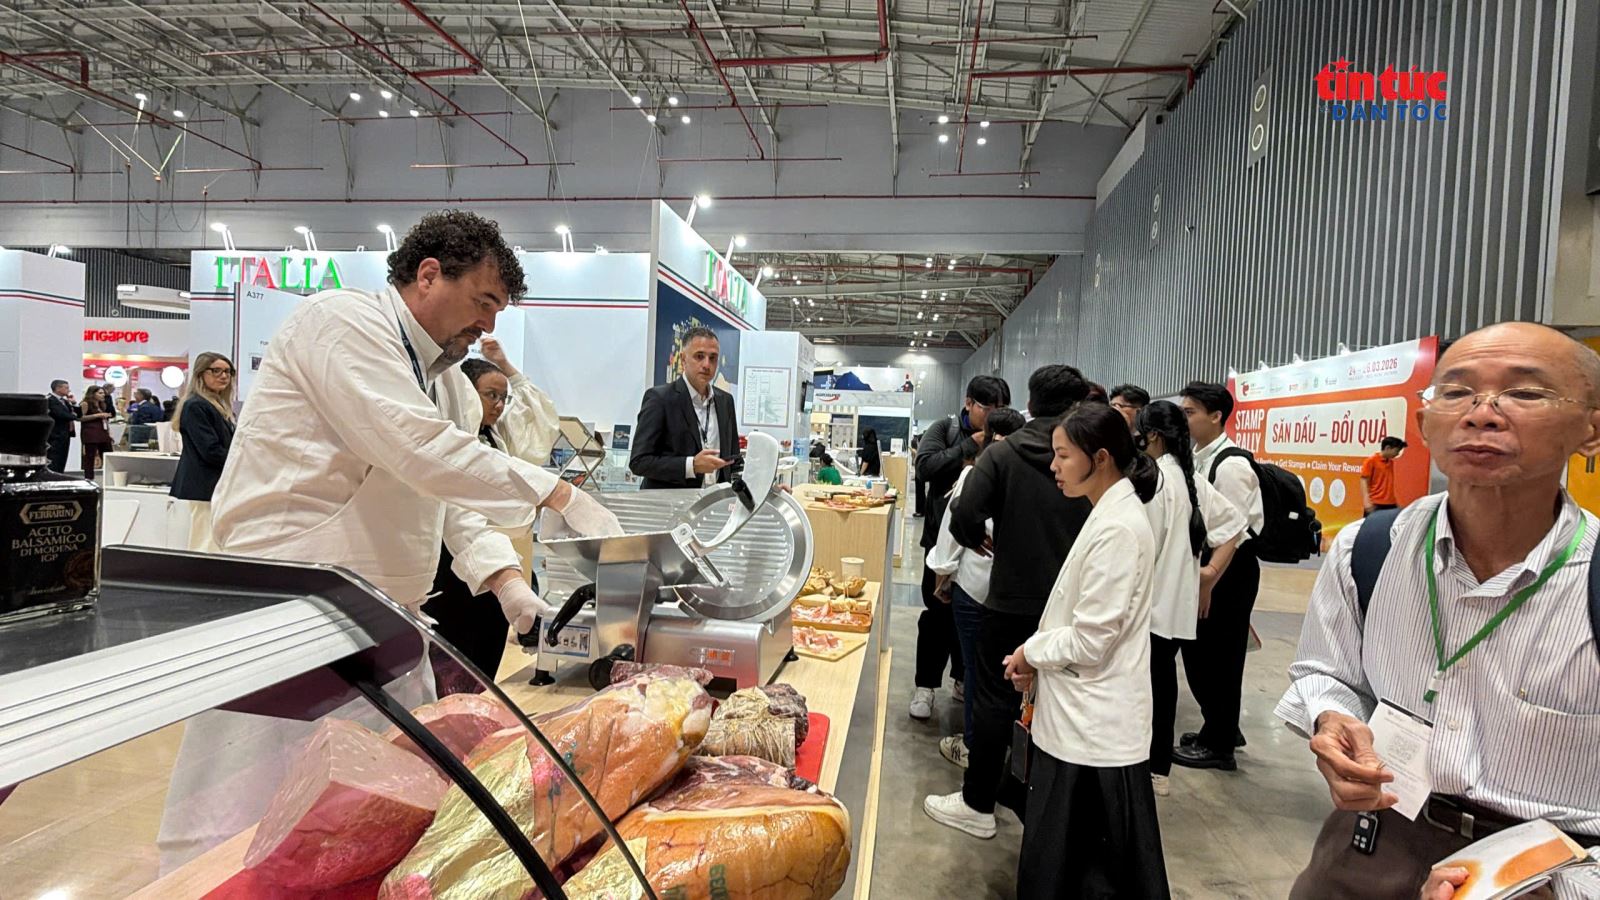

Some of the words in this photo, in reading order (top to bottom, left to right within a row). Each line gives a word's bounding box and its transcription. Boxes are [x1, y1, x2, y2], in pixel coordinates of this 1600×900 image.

[214, 256, 343, 289] ITALIA
[246, 290, 264, 300] A377
[1235, 408, 1265, 430] STAMP
[1272, 419, 1292, 443] SĂN
[1294, 414, 1317, 443] DẤU
[1331, 410, 1355, 444] ĐỔI
[1358, 410, 1388, 448] QUÀ
[1236, 432, 1262, 454] RALLY
[1342, 462, 1363, 473] Rewar
[29, 525, 72, 537] ACETO
[11, 533, 87, 550] BALSAMICO
[20, 548, 32, 557] DI
[34, 544, 78, 554] MODENA
[41, 553, 59, 562] IGP
